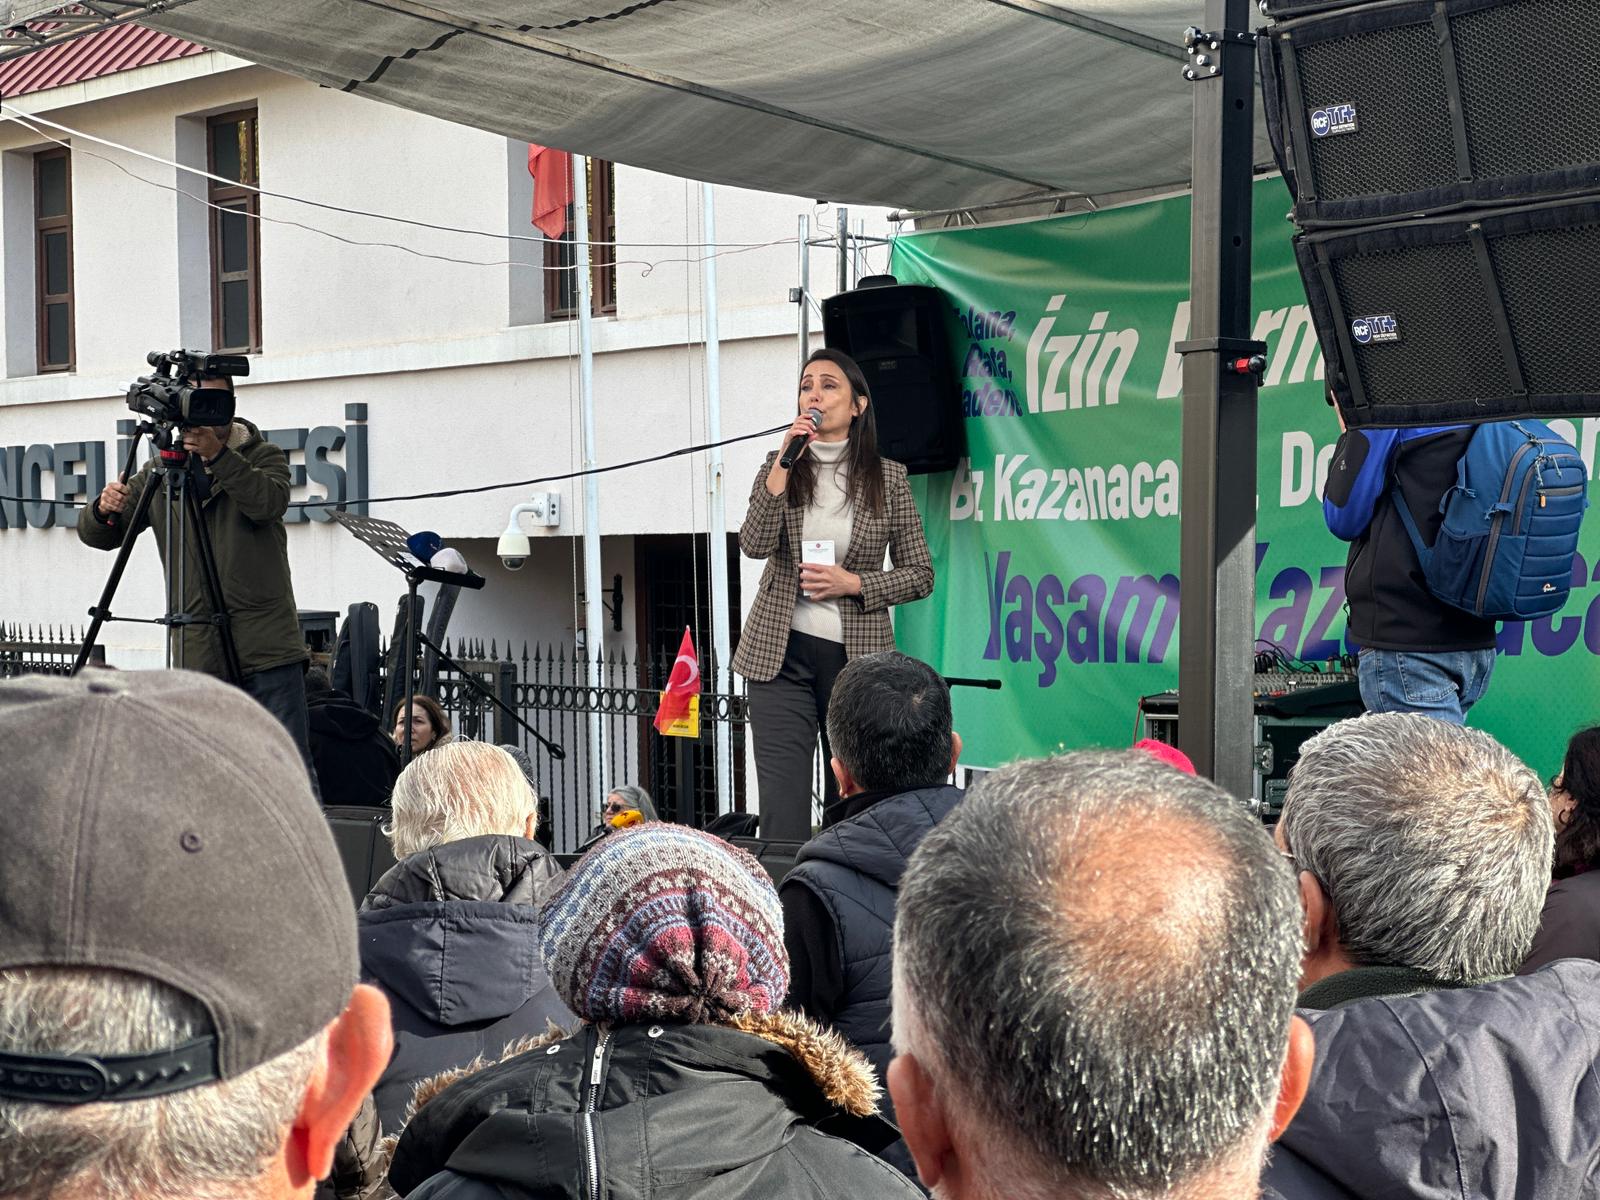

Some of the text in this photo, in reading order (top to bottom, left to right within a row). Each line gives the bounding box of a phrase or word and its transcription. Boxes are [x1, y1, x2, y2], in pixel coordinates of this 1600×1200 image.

[1026, 294, 1139, 414] İzin
[993, 452, 1182, 522] Kazanaca
[982, 551, 1180, 688] Yaşam
